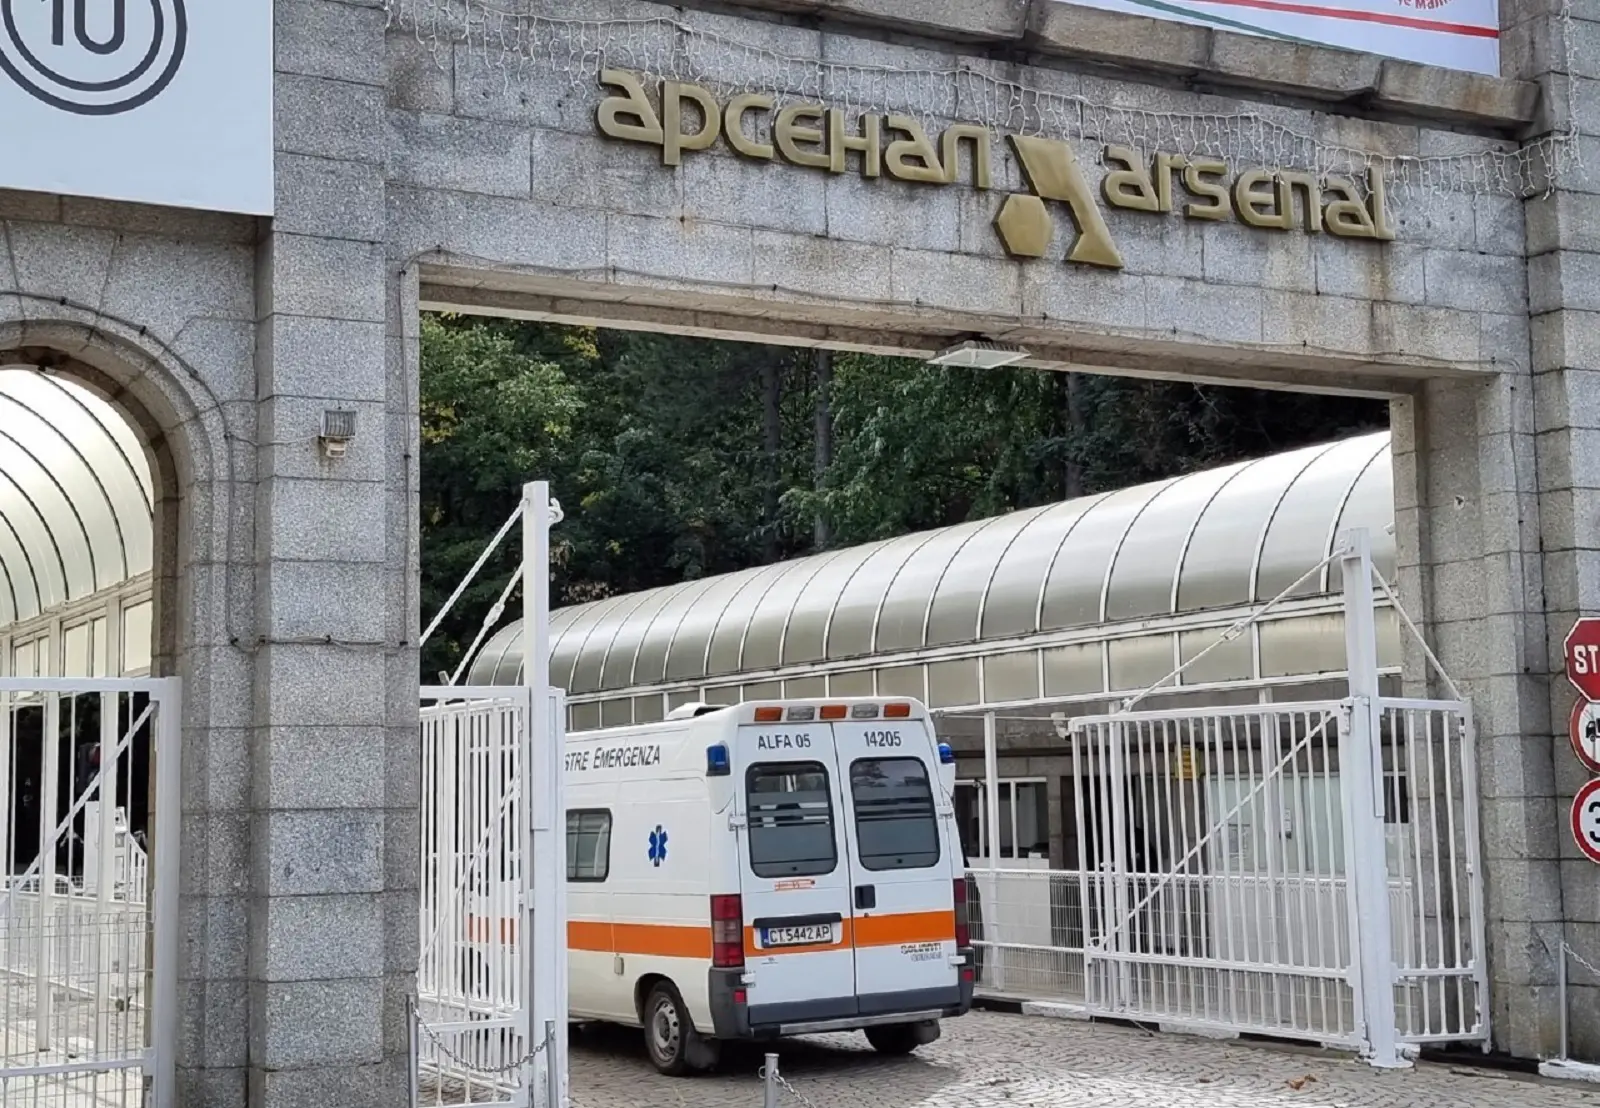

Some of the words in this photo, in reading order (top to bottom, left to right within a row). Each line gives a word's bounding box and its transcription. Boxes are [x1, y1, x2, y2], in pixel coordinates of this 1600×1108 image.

[1100, 144, 1396, 241] arsenal
[758, 734, 792, 749] ALFA
[796, 733, 811, 748] 05
[863, 731, 902, 747] 14205
